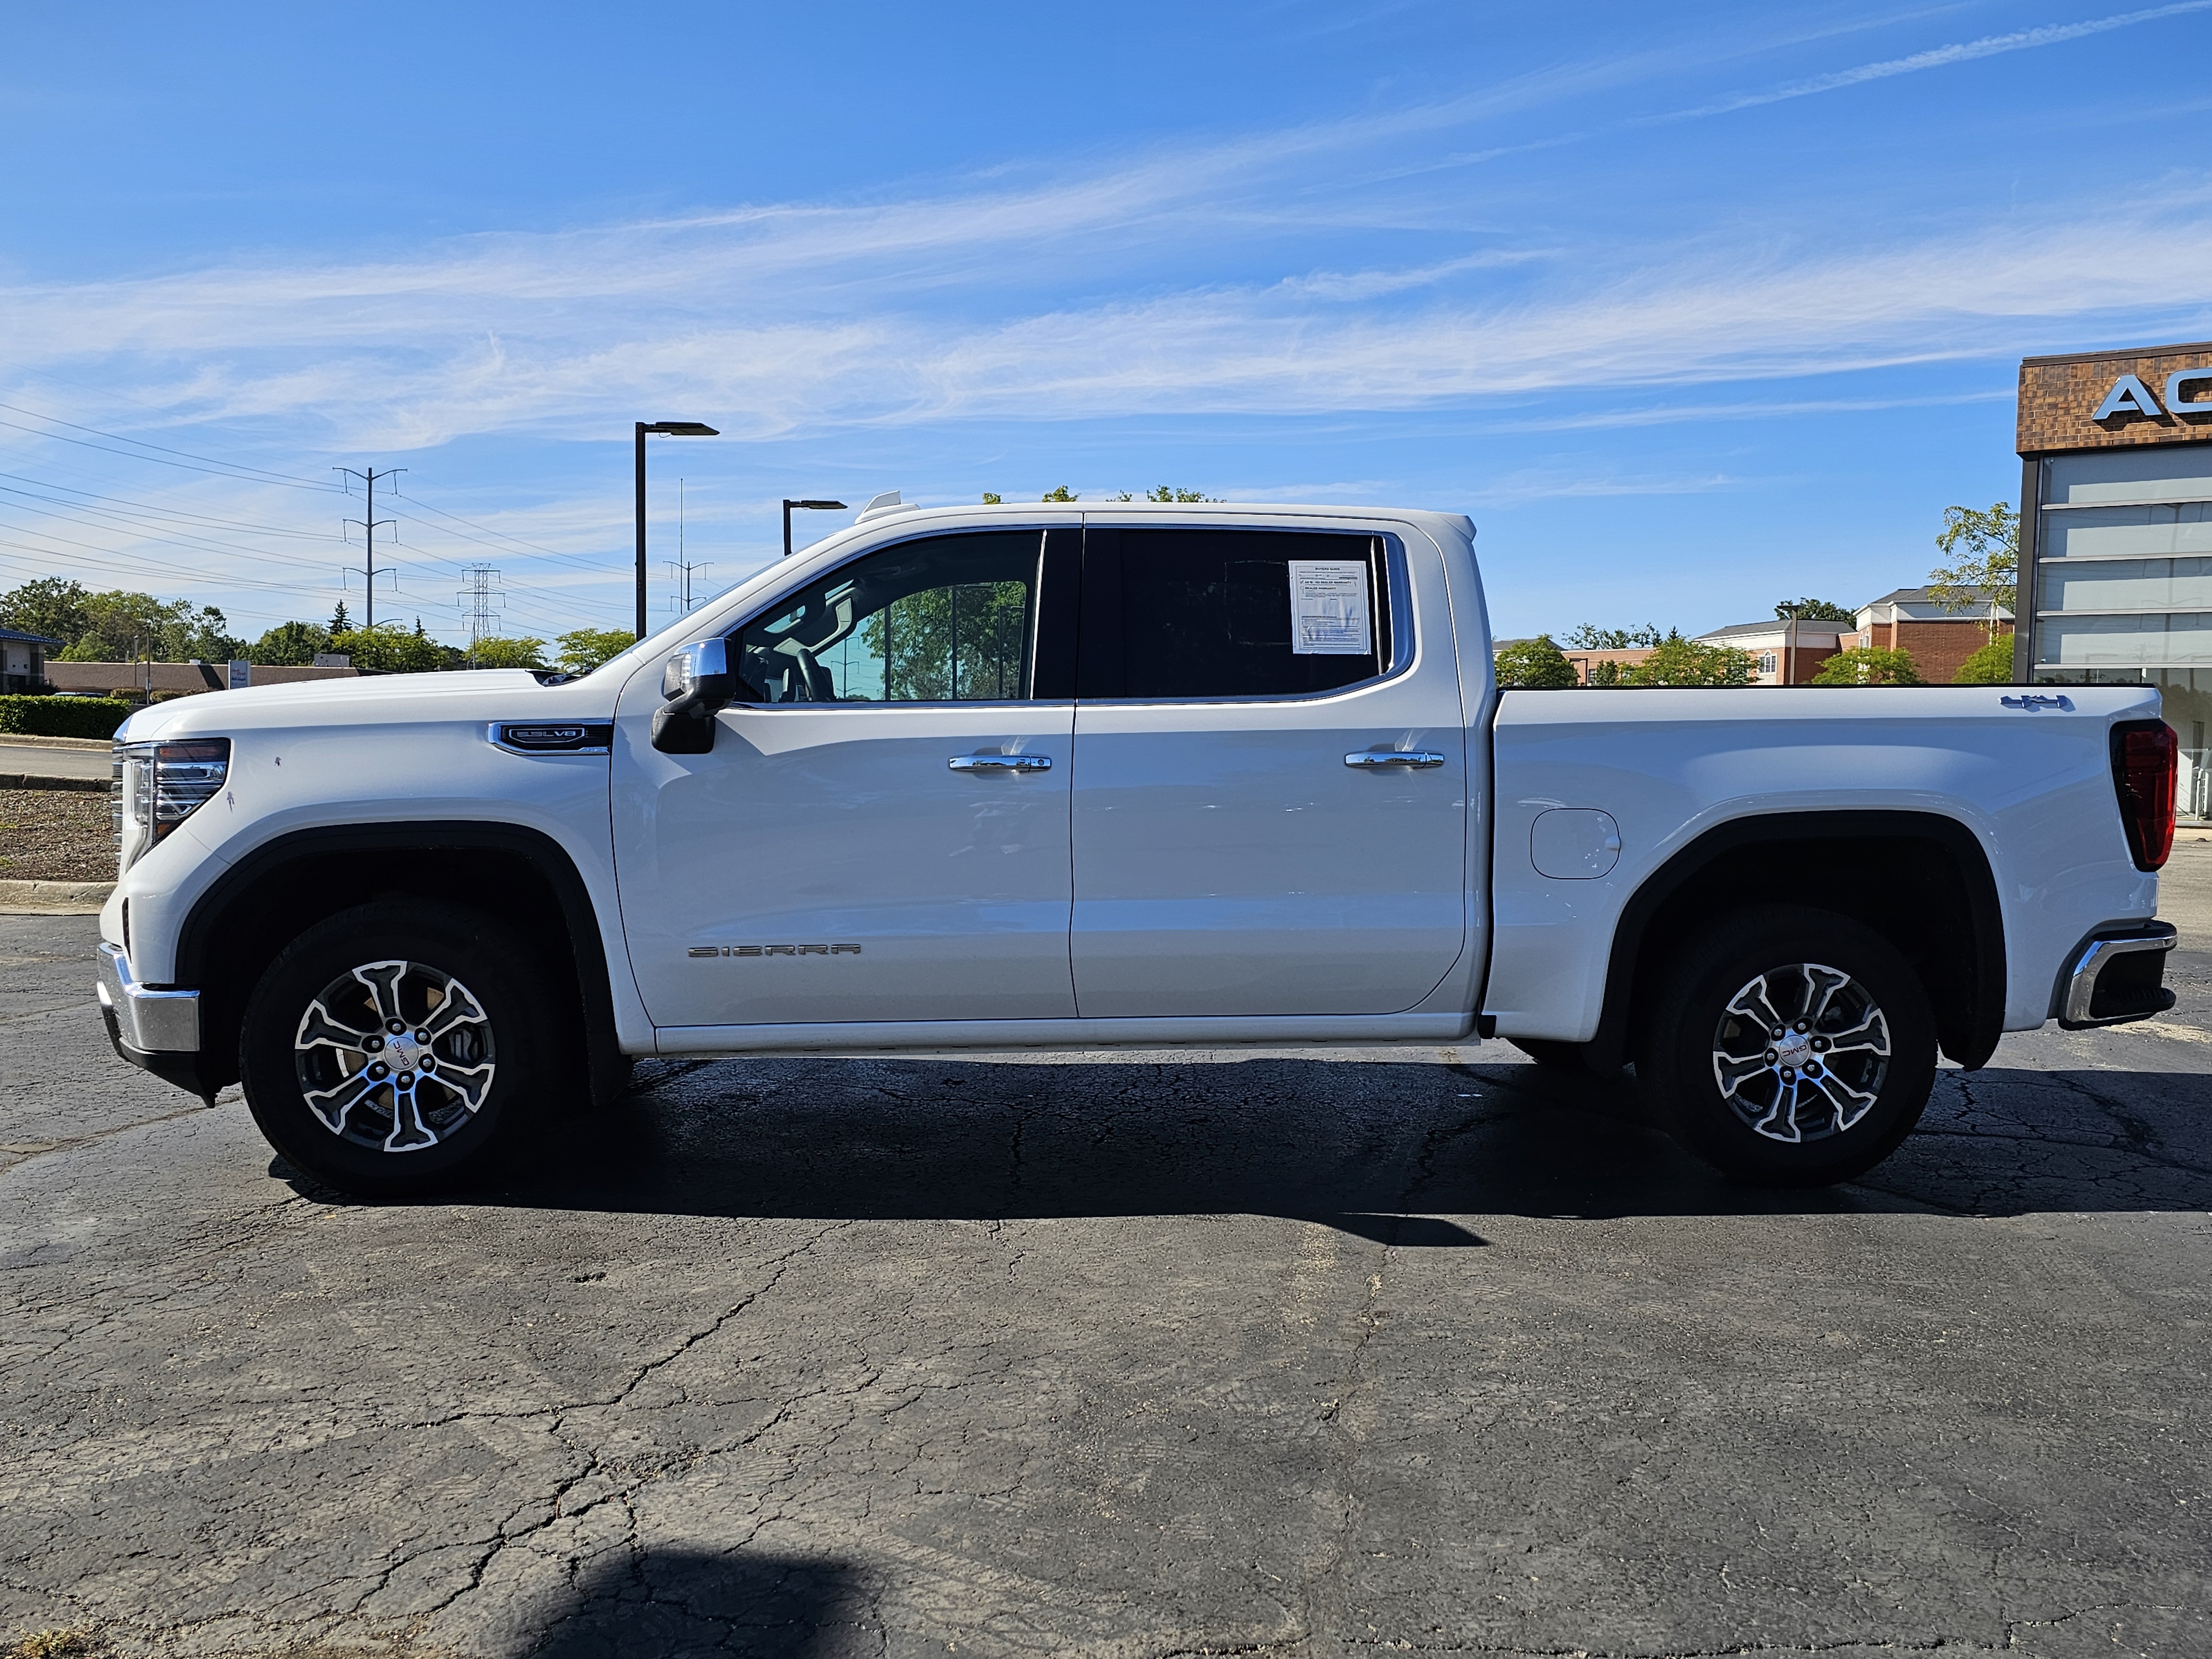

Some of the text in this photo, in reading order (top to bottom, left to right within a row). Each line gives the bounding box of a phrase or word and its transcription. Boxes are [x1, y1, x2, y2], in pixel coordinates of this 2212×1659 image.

[2091, 367, 2212, 420] AC
[688, 944, 860, 957] SIERRA
[393, 1041, 410, 1066] GMC
[1782, 1045, 1807, 1057] GMC
